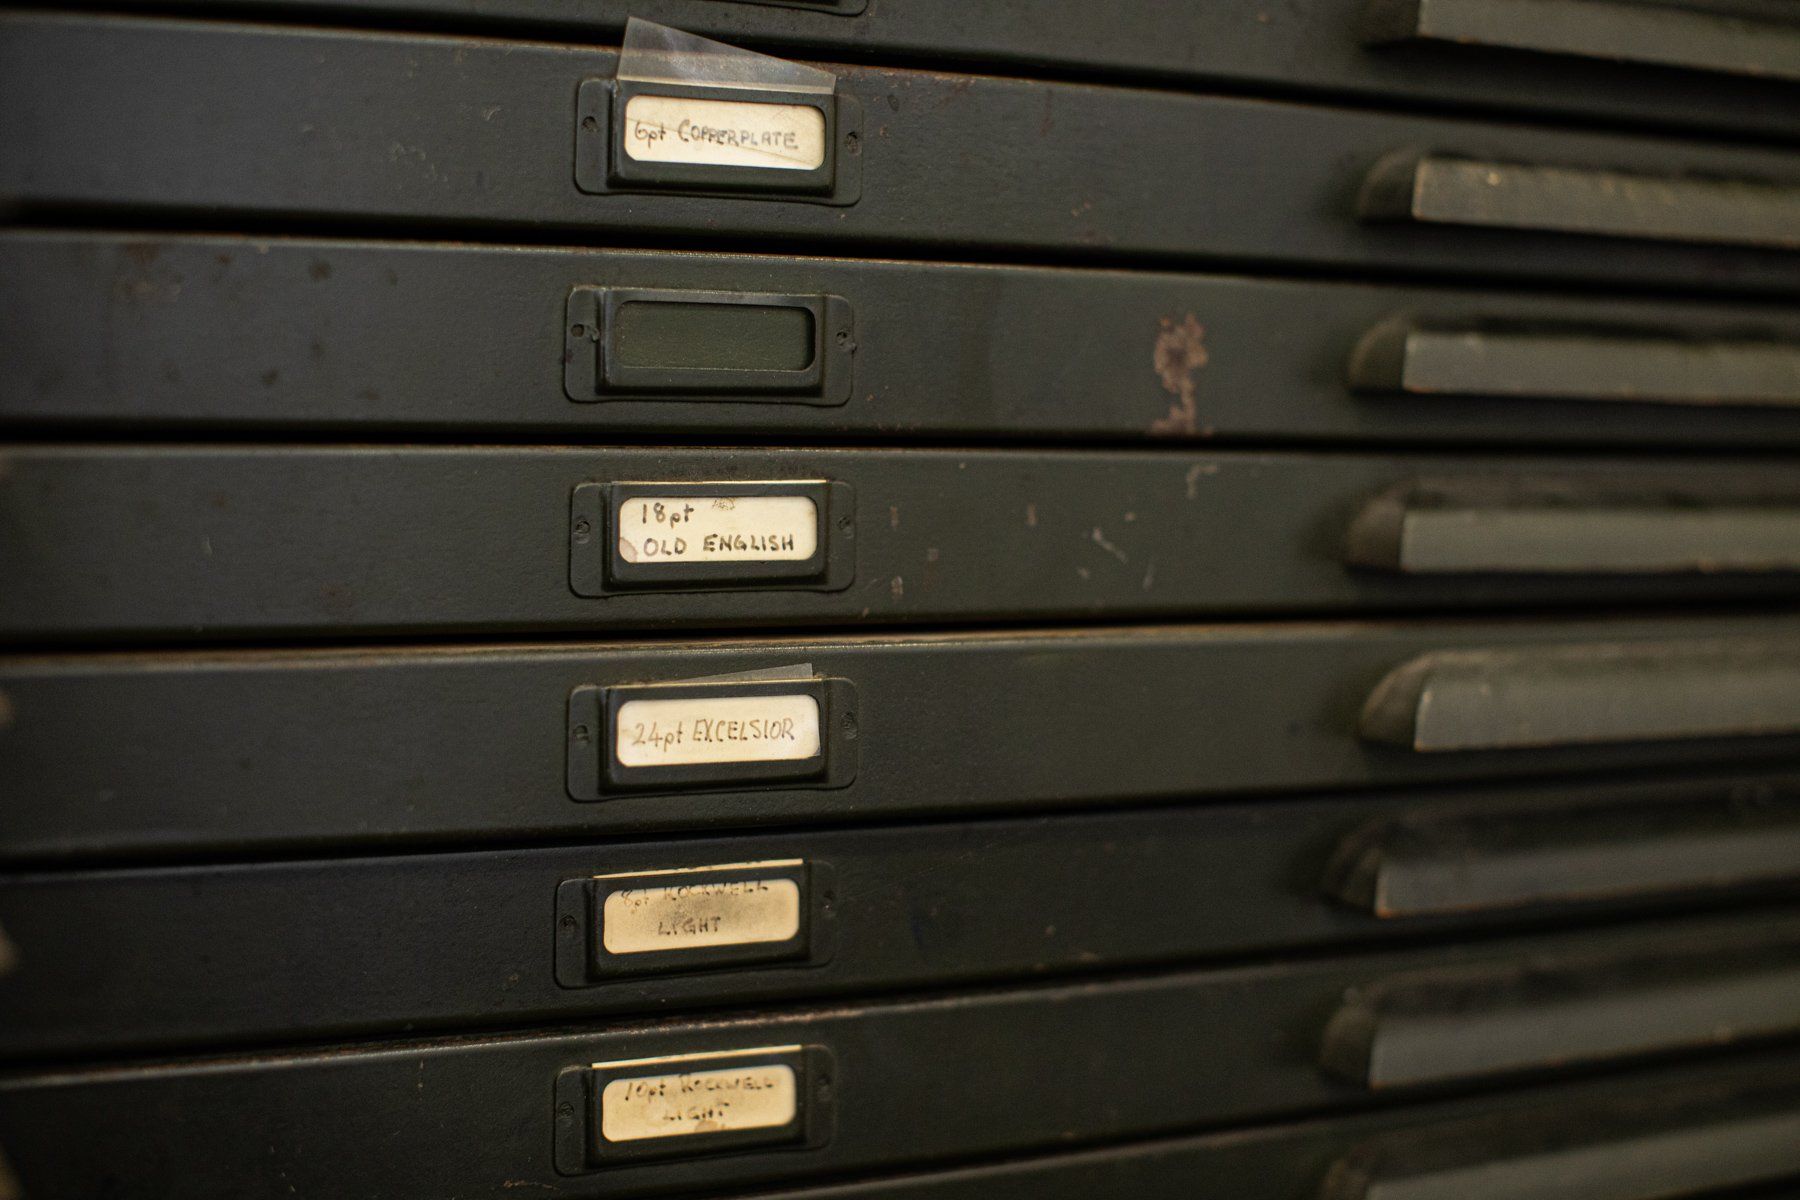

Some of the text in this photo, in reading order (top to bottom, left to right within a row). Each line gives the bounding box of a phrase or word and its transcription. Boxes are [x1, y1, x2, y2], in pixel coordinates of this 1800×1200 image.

[635, 119, 799, 150] 6pt COPPERPLATE
[642, 502, 695, 528] 18pt
[643, 533, 795, 556] OLD ENGLISH
[632, 717, 795, 752] 24pt EXCELSIOR
[658, 916, 721, 935] LIGHT
